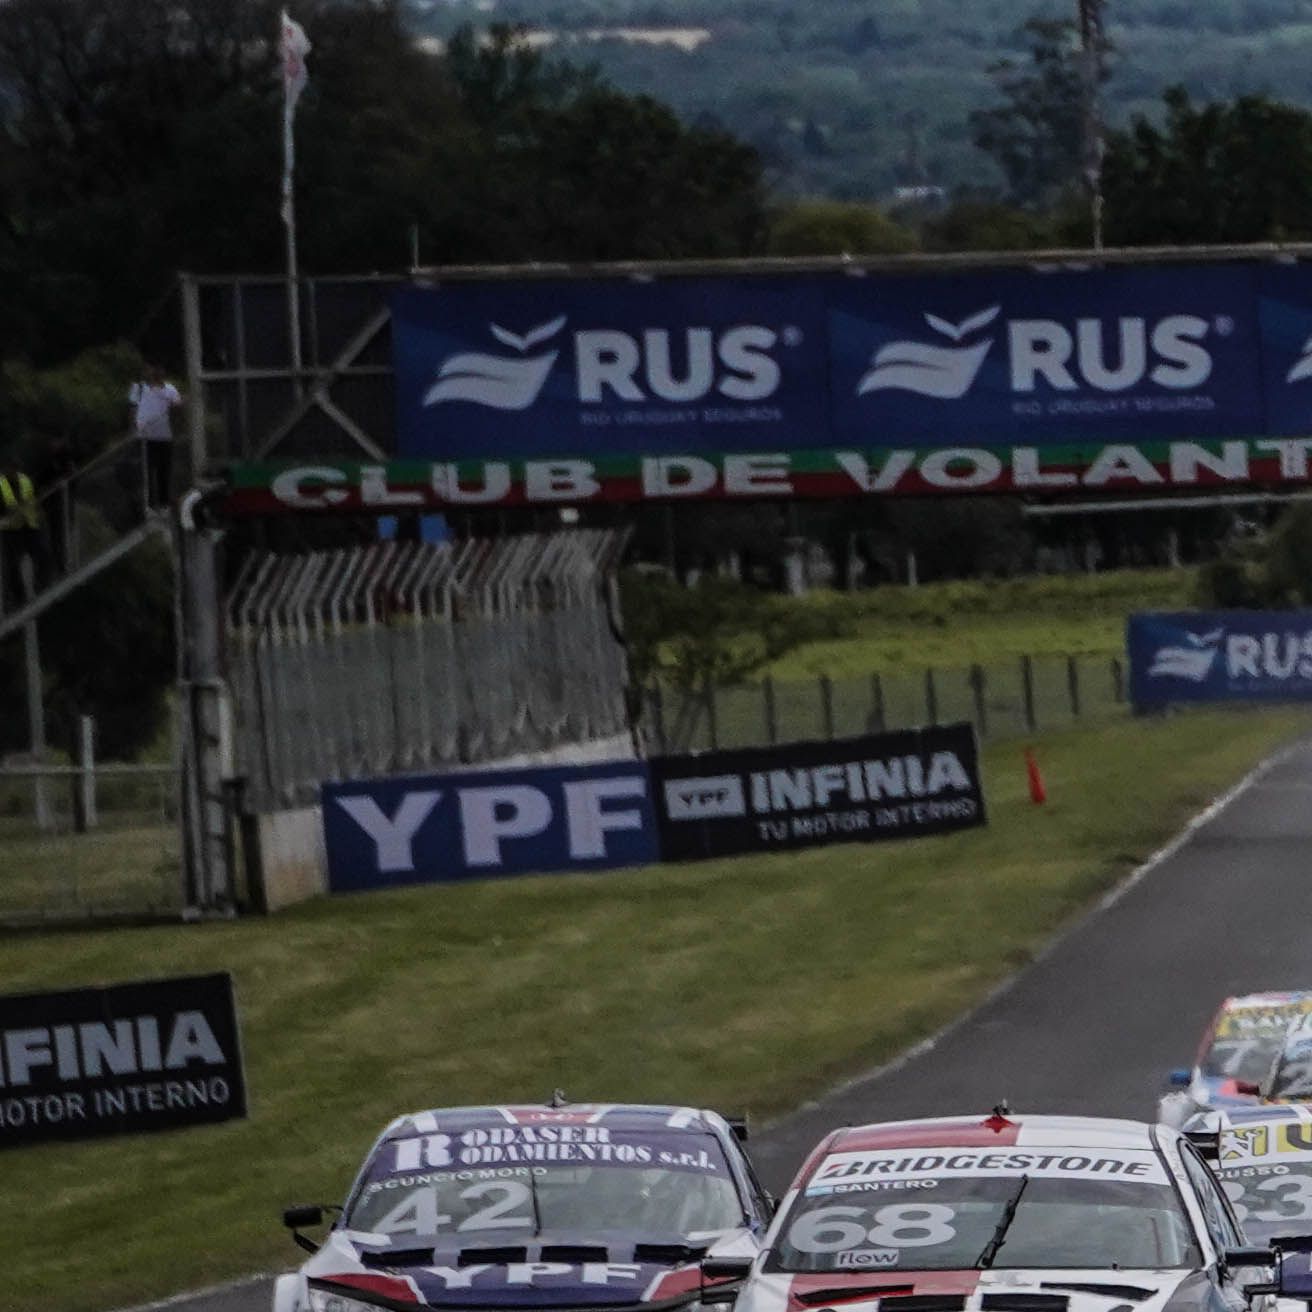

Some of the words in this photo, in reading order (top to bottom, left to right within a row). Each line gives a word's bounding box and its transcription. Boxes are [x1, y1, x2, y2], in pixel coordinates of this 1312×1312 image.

[575, 325, 781, 402] RUS
[1007, 314, 1213, 391] RUS
[271, 459, 600, 507] CLUB
[641, 453, 795, 497] DE
[750, 750, 973, 814] INFINIA
[336, 776, 647, 873] YPF
[0, 1009, 227, 1087] FINIA
[0, 1092, 85, 1128] OTOR
[93, 1075, 231, 1119] INTERNO
[372, 1180, 534, 1236] 42
[833, 1179, 939, 1194] SANTERO
[788, 1203, 957, 1253] 68
[420, 1262, 643, 1289] YPF
